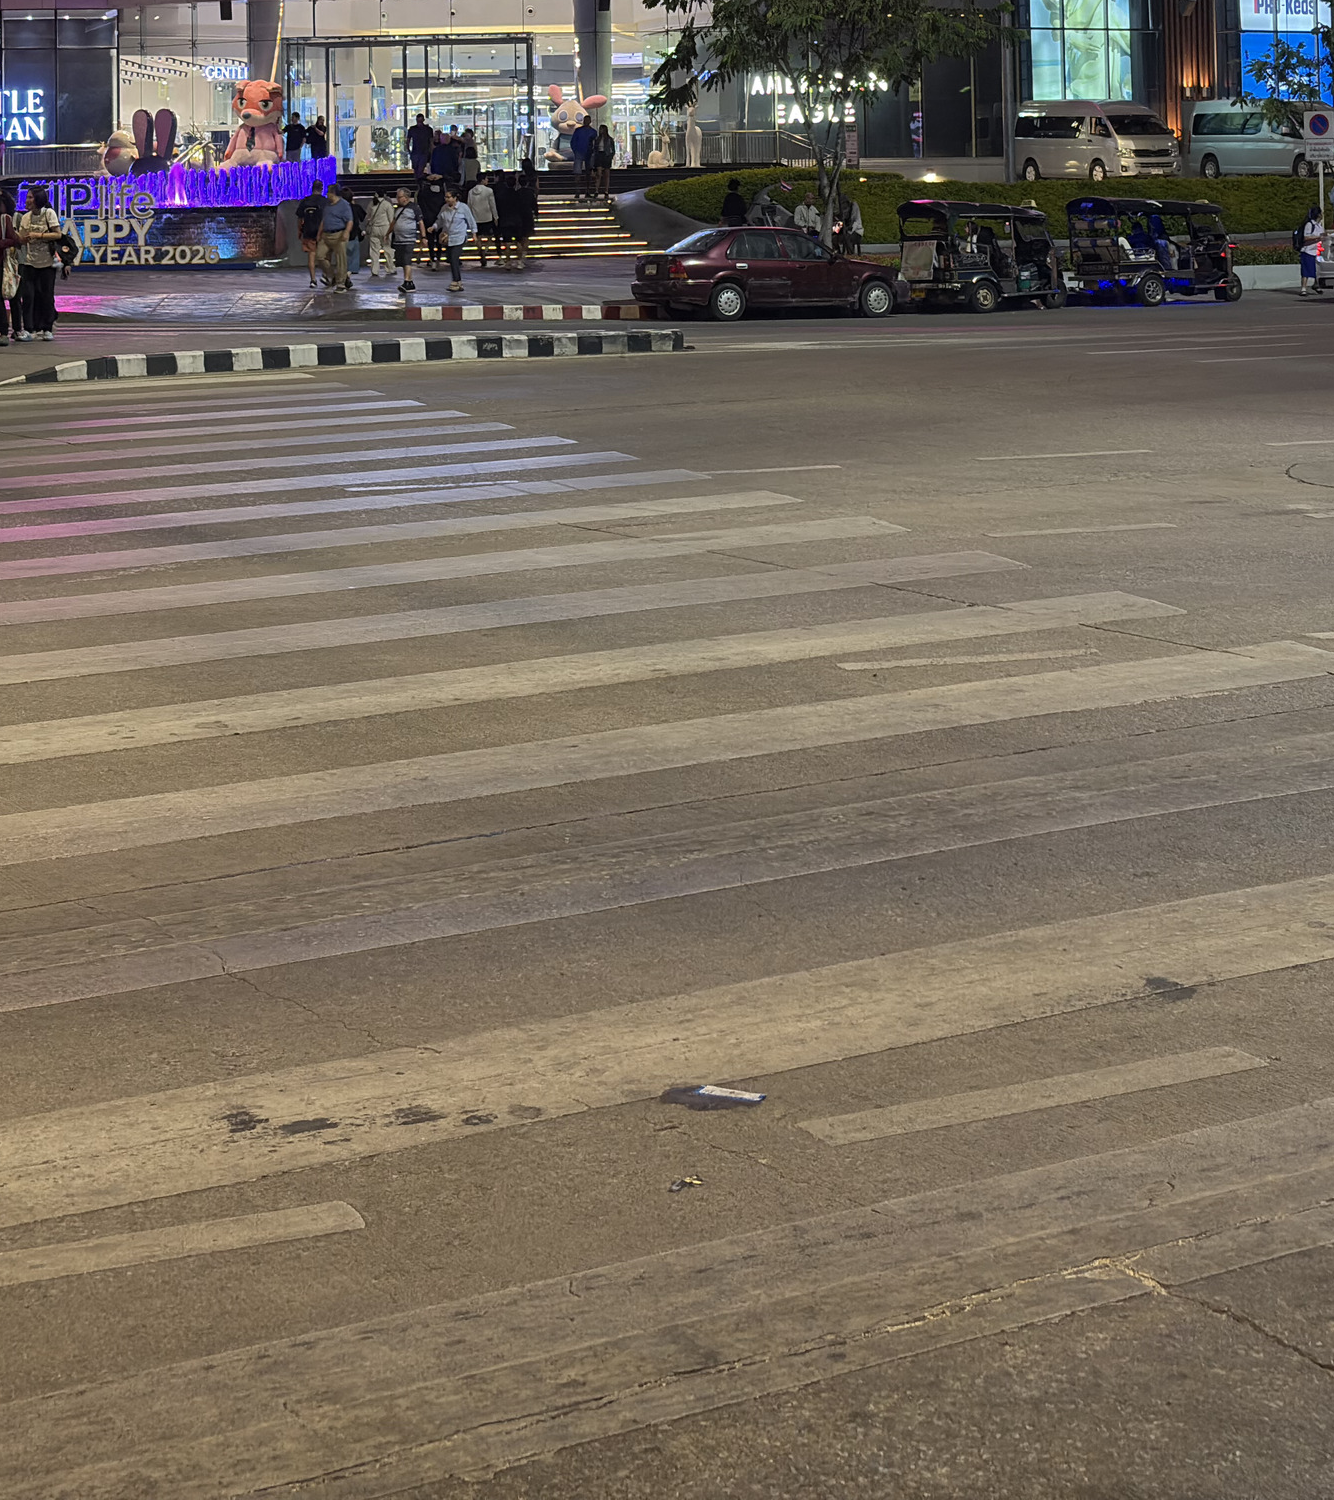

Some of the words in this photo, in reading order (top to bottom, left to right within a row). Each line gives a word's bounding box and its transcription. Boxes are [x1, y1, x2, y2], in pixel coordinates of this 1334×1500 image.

[205, 65, 248, 80] GENTL
[60, 218, 155, 247] APPY
[88, 246, 156, 266] YEAR
[160, 245, 220, 265] 2026
